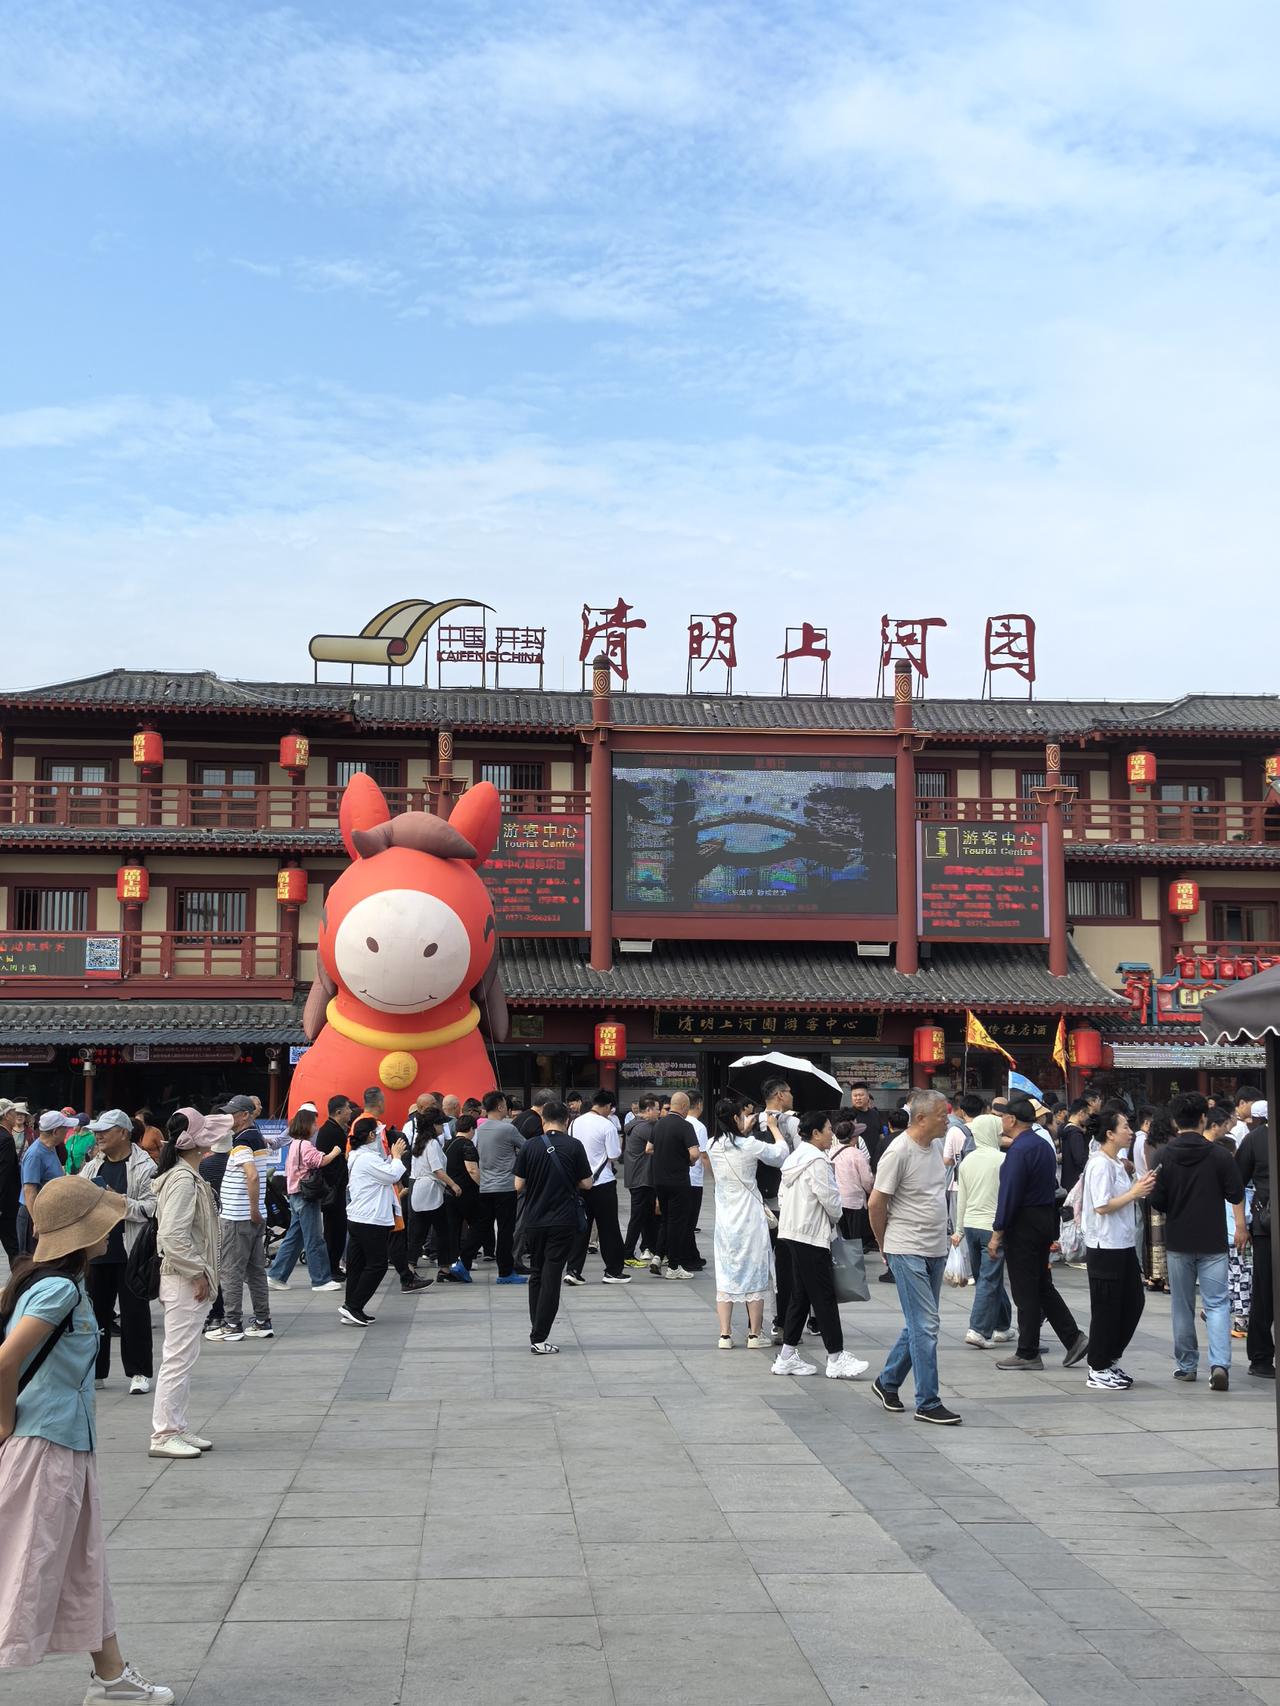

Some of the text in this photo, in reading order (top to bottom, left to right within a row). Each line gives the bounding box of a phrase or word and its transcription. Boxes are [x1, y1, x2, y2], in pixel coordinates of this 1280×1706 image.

[438, 624, 547, 651] 中国 开封
[437, 650, 545, 664] KAIFENG CHINA
[503, 823, 578, 839] 游客中心
[962, 829, 1036, 846] 游客中心
[504, 840, 539, 848] Tourist
[963, 847, 1033, 857] Tourist Centre
